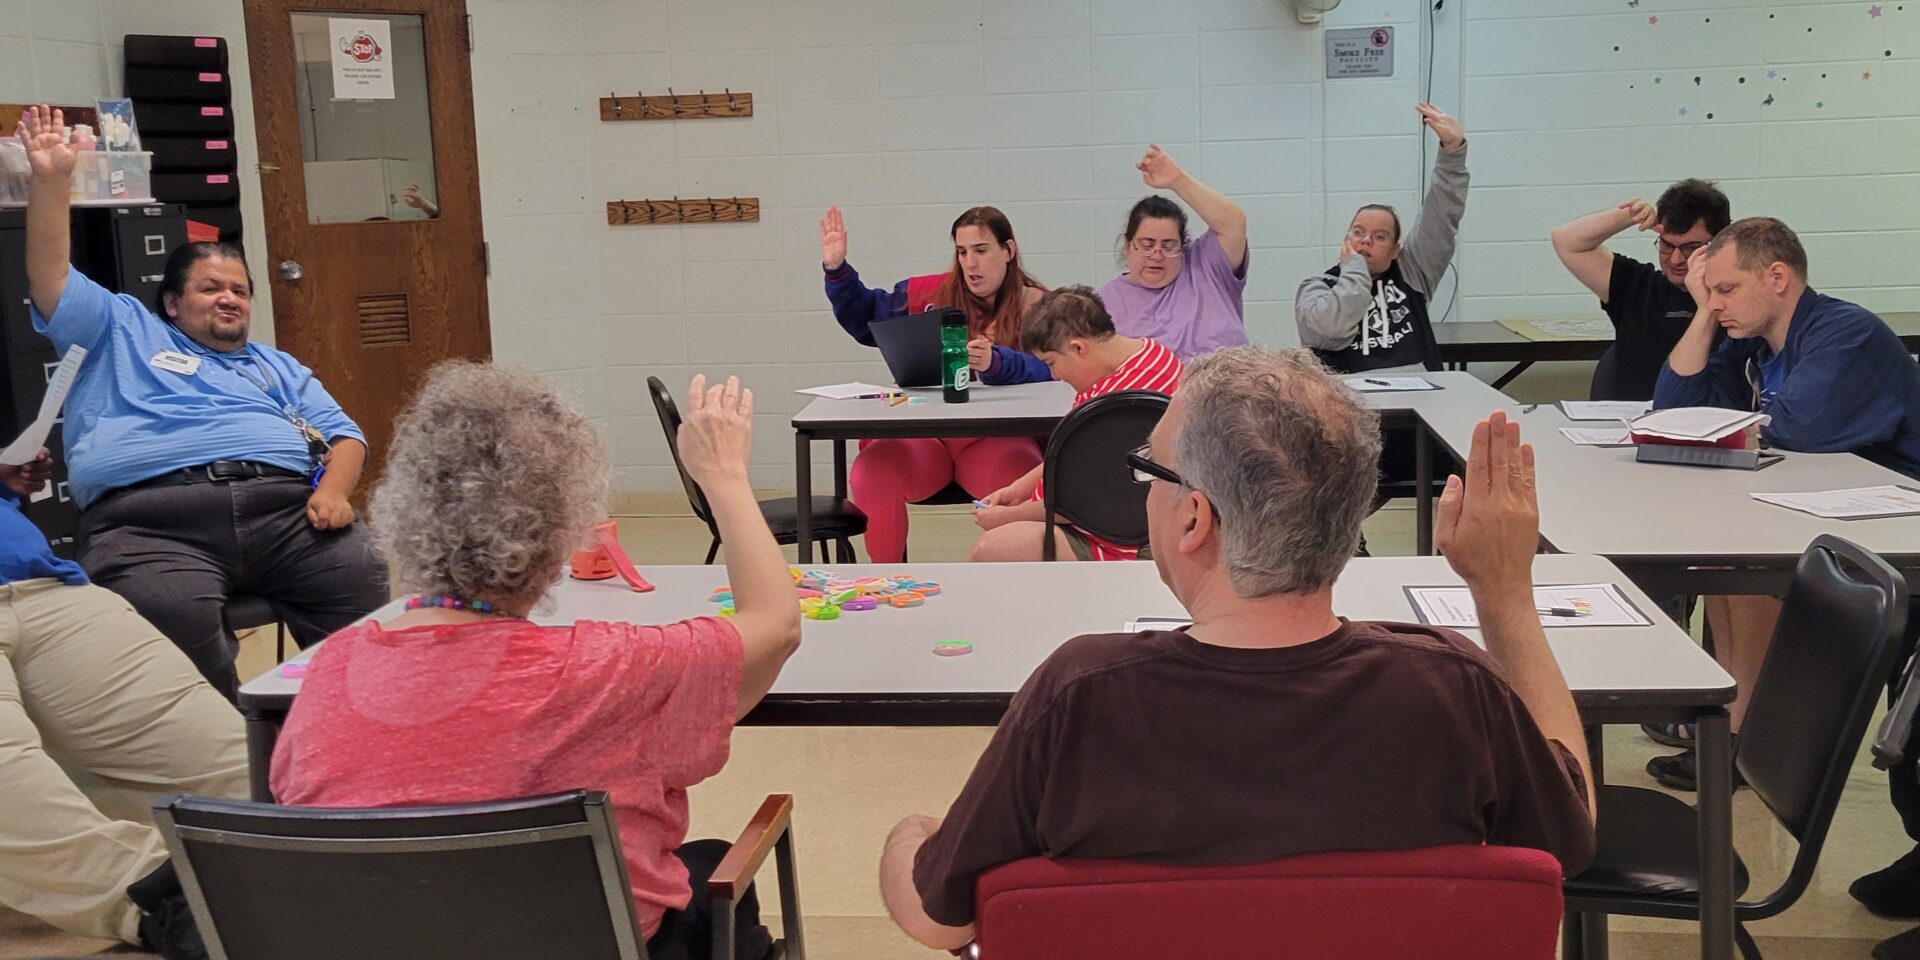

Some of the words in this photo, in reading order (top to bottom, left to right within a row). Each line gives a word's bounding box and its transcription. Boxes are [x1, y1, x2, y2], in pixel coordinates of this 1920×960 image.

[353, 43, 373, 56] STOP
[1334, 49, 1360, 58] SMOKE
[1364, 48, 1385, 56] FREE
